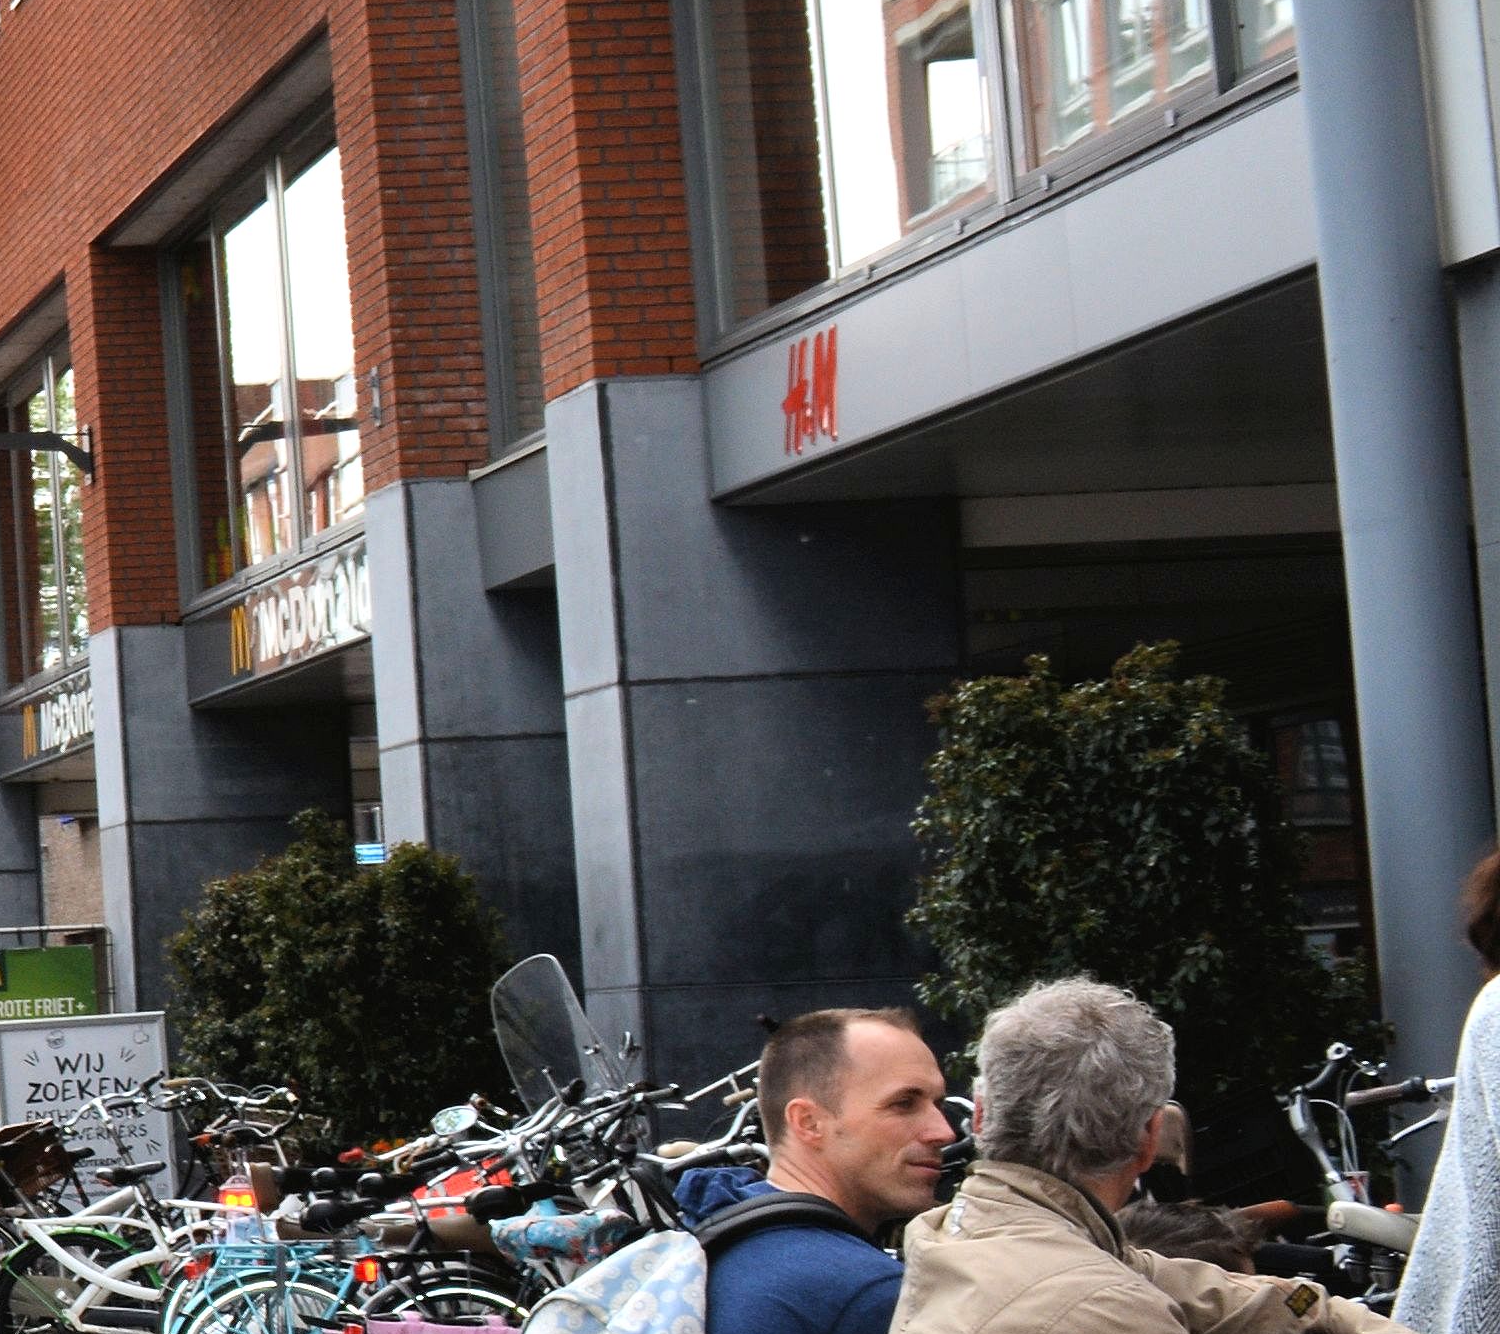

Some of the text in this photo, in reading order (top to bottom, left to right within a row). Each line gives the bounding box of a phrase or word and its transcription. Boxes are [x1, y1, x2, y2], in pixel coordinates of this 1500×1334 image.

[782, 323, 838, 456] H&M
[35, 997, 75, 1015] FRIET
[55, 1052, 104, 1075] WIJ
